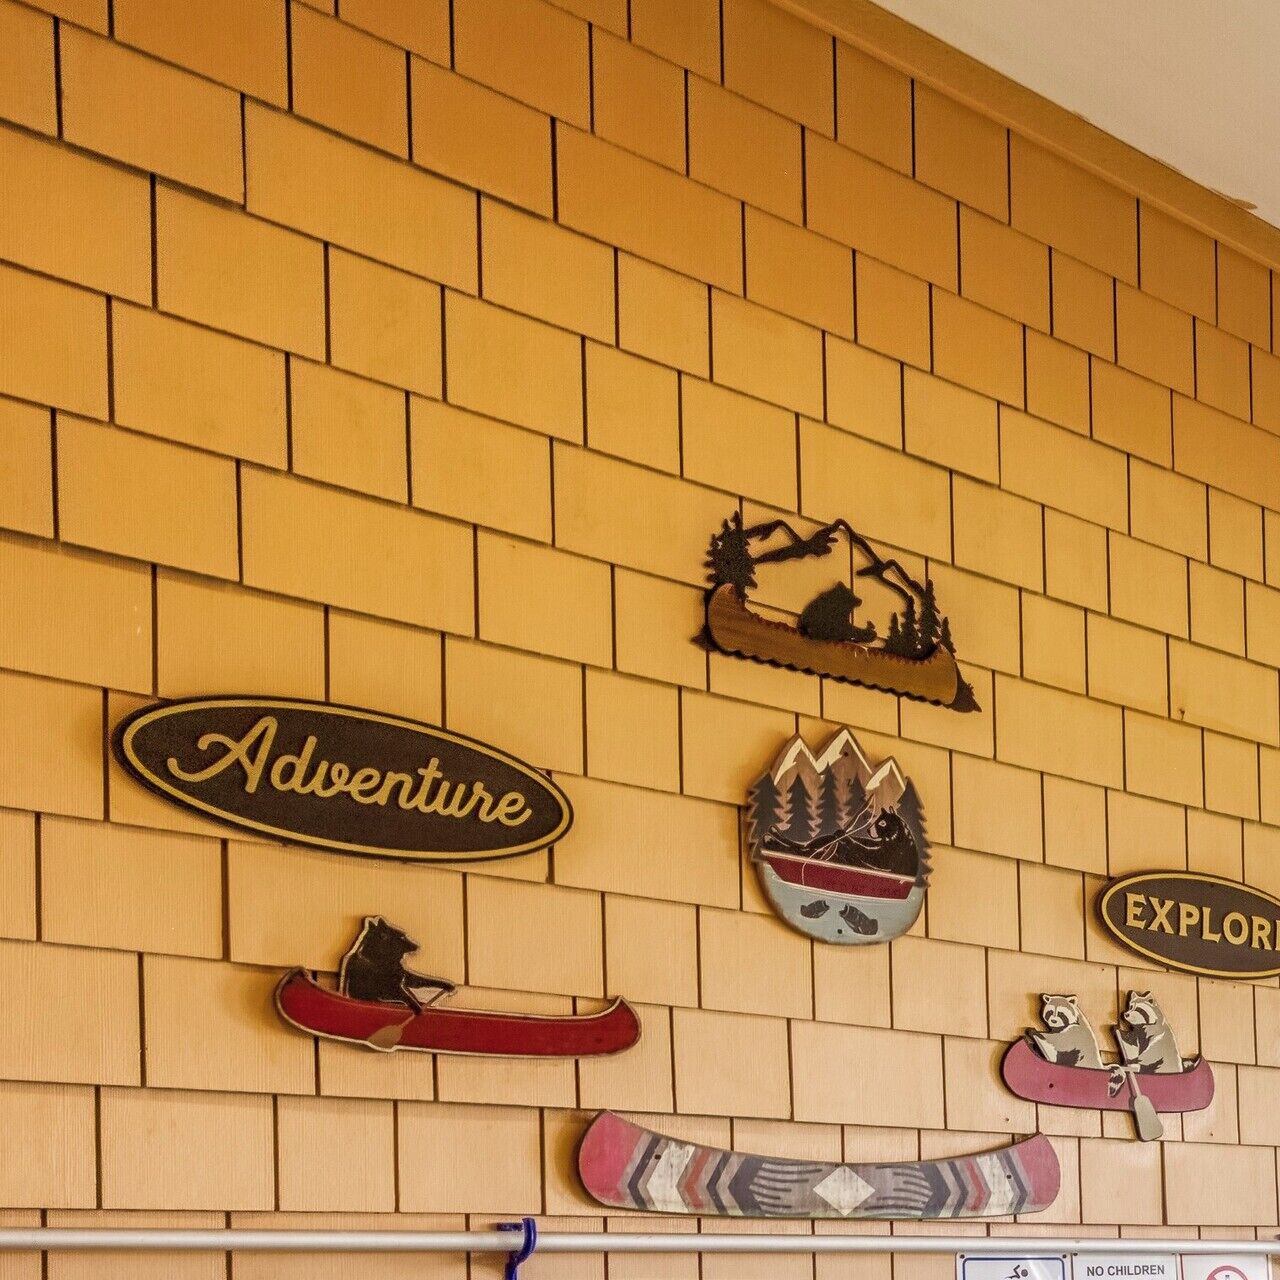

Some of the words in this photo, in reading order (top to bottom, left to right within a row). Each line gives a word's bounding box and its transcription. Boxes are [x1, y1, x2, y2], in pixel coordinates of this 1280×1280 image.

[166, 715, 532, 827] Adventure
[1086, 1266, 1103, 1276] NO
[1107, 1265, 1165, 1276] CHILDREN
